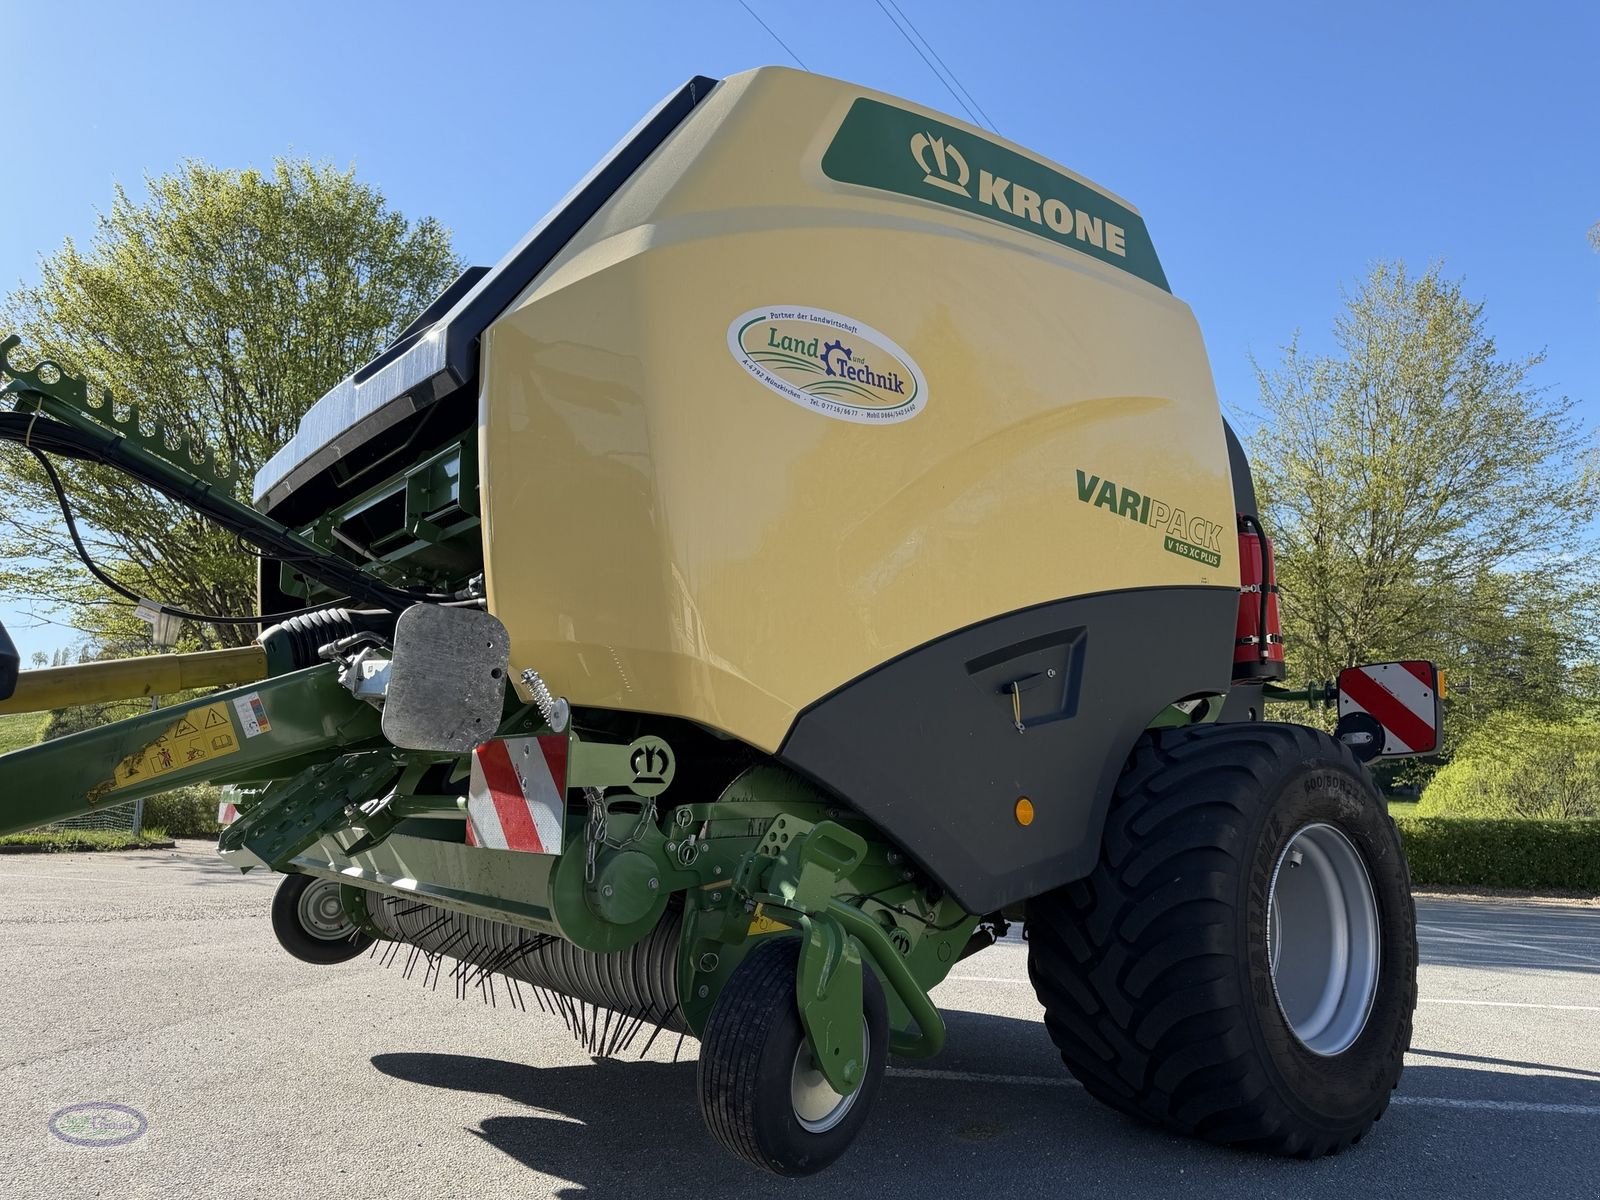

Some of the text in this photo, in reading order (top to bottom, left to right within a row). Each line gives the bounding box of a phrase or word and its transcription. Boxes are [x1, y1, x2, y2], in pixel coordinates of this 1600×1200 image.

[978, 169, 1126, 257] KRONE
[797, 312, 807, 320] der
[810, 314, 858, 333] Landwirtschaft
[768, 327, 819, 358] Land
[837, 358, 905, 394] Technik
[853, 356, 865, 365] und
[1076, 469, 1223, 553] VARIPACK
[1167, 539, 1218, 565] V 165 XC PLUS
